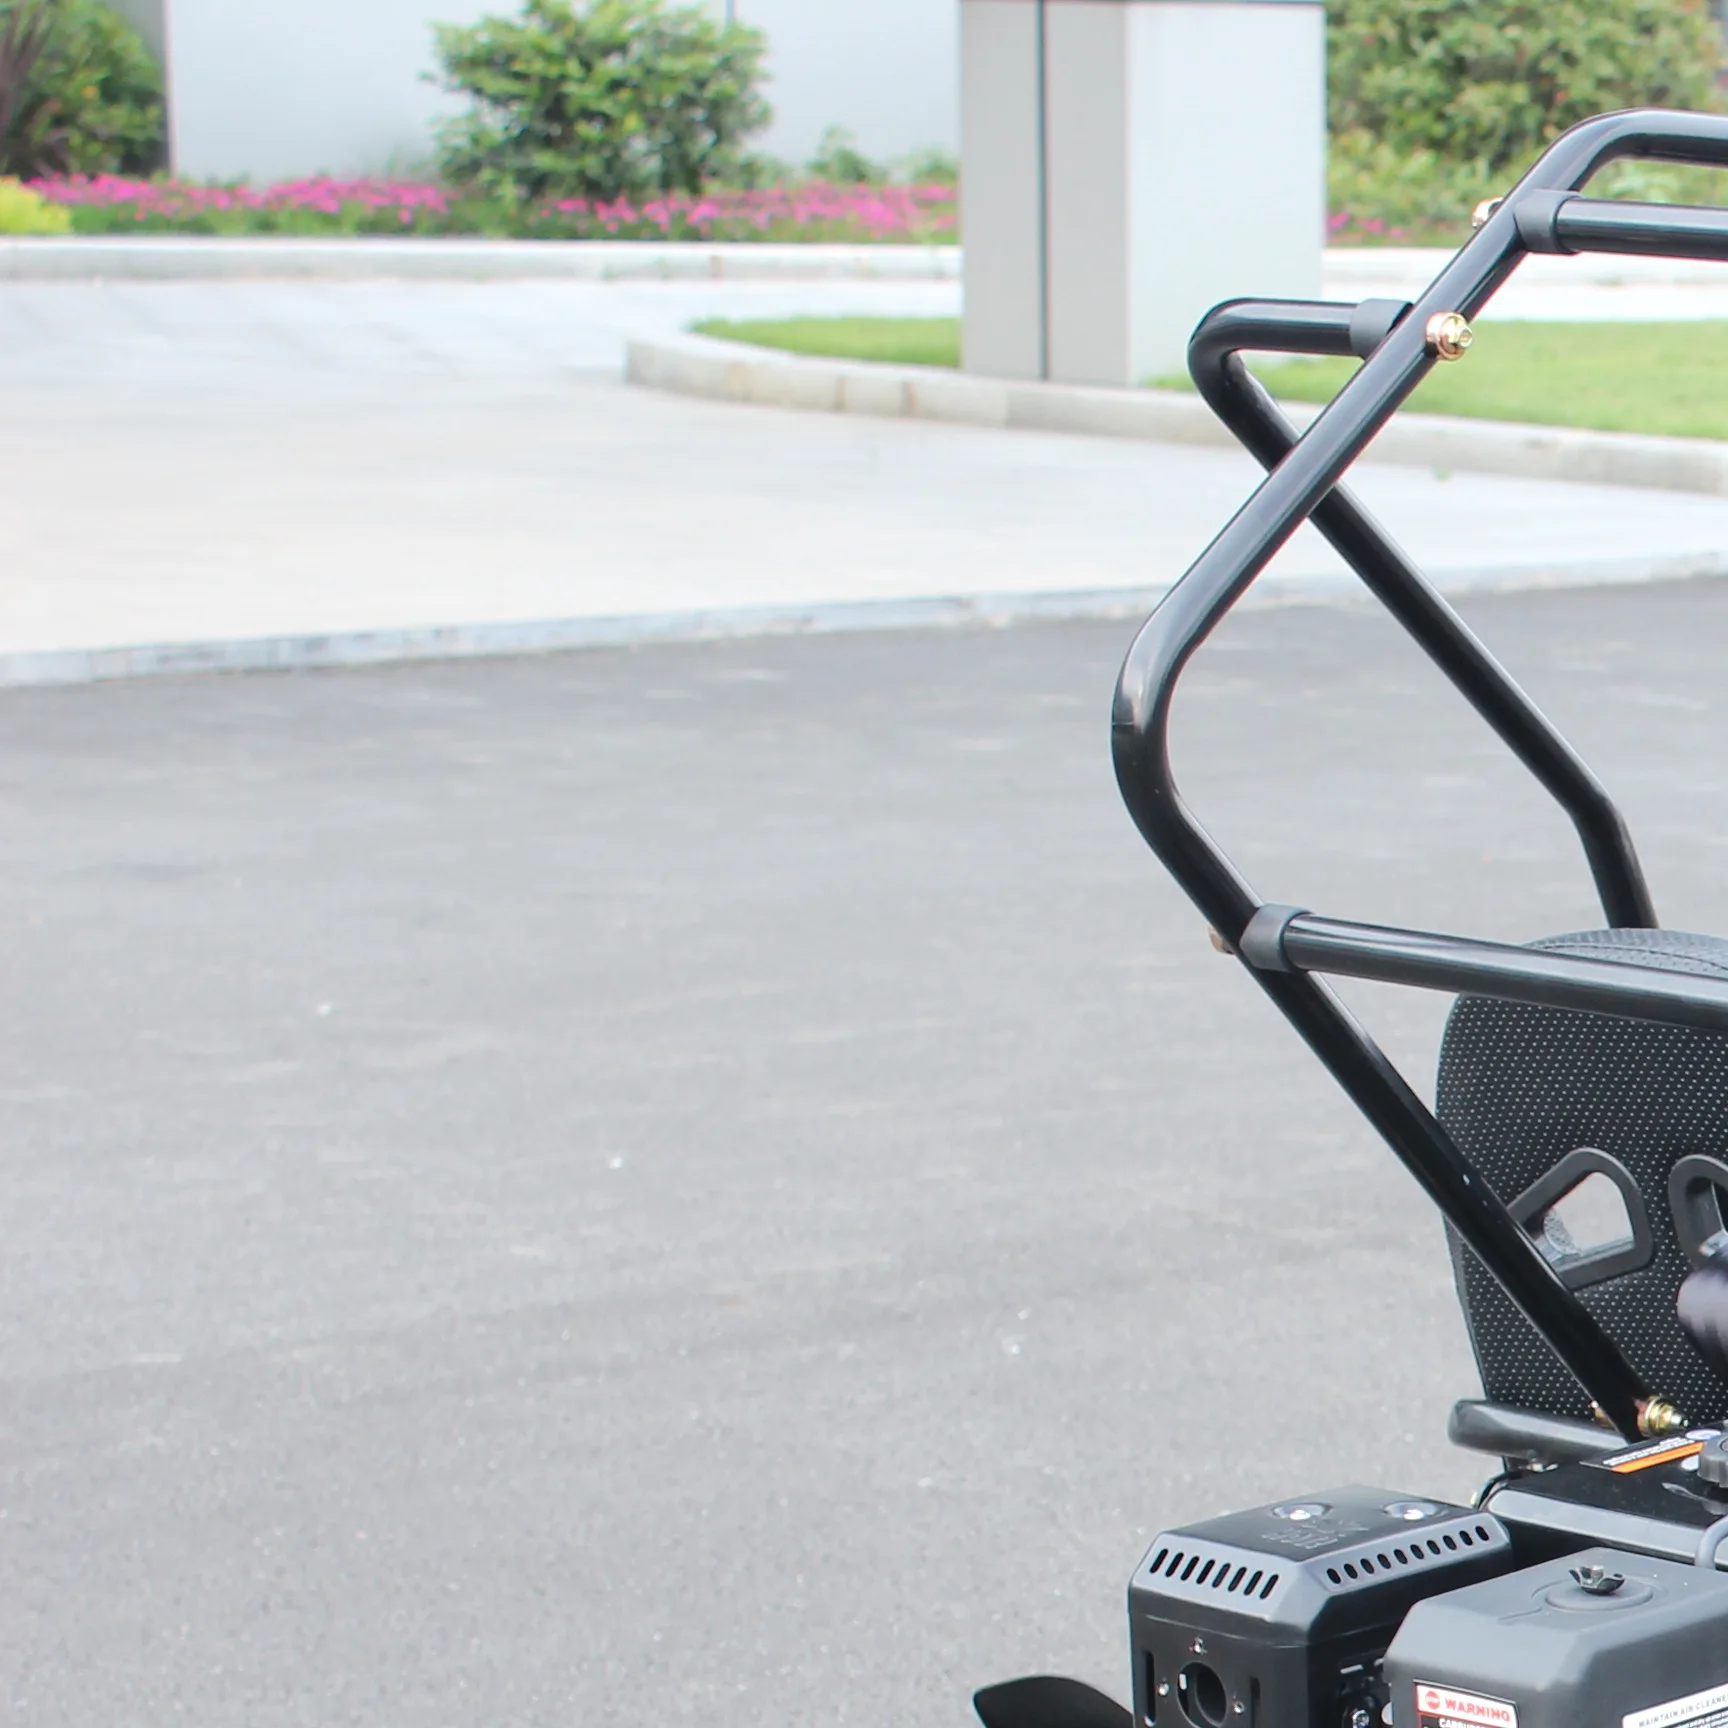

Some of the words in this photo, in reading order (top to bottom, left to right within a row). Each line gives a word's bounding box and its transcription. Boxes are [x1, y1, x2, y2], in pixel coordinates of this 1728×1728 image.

[1445, 1698, 1511, 1723] WARNING
[1638, 1709, 1680, 1728] MAINTAIN
[1680, 1703, 1695, 1717] AIR
